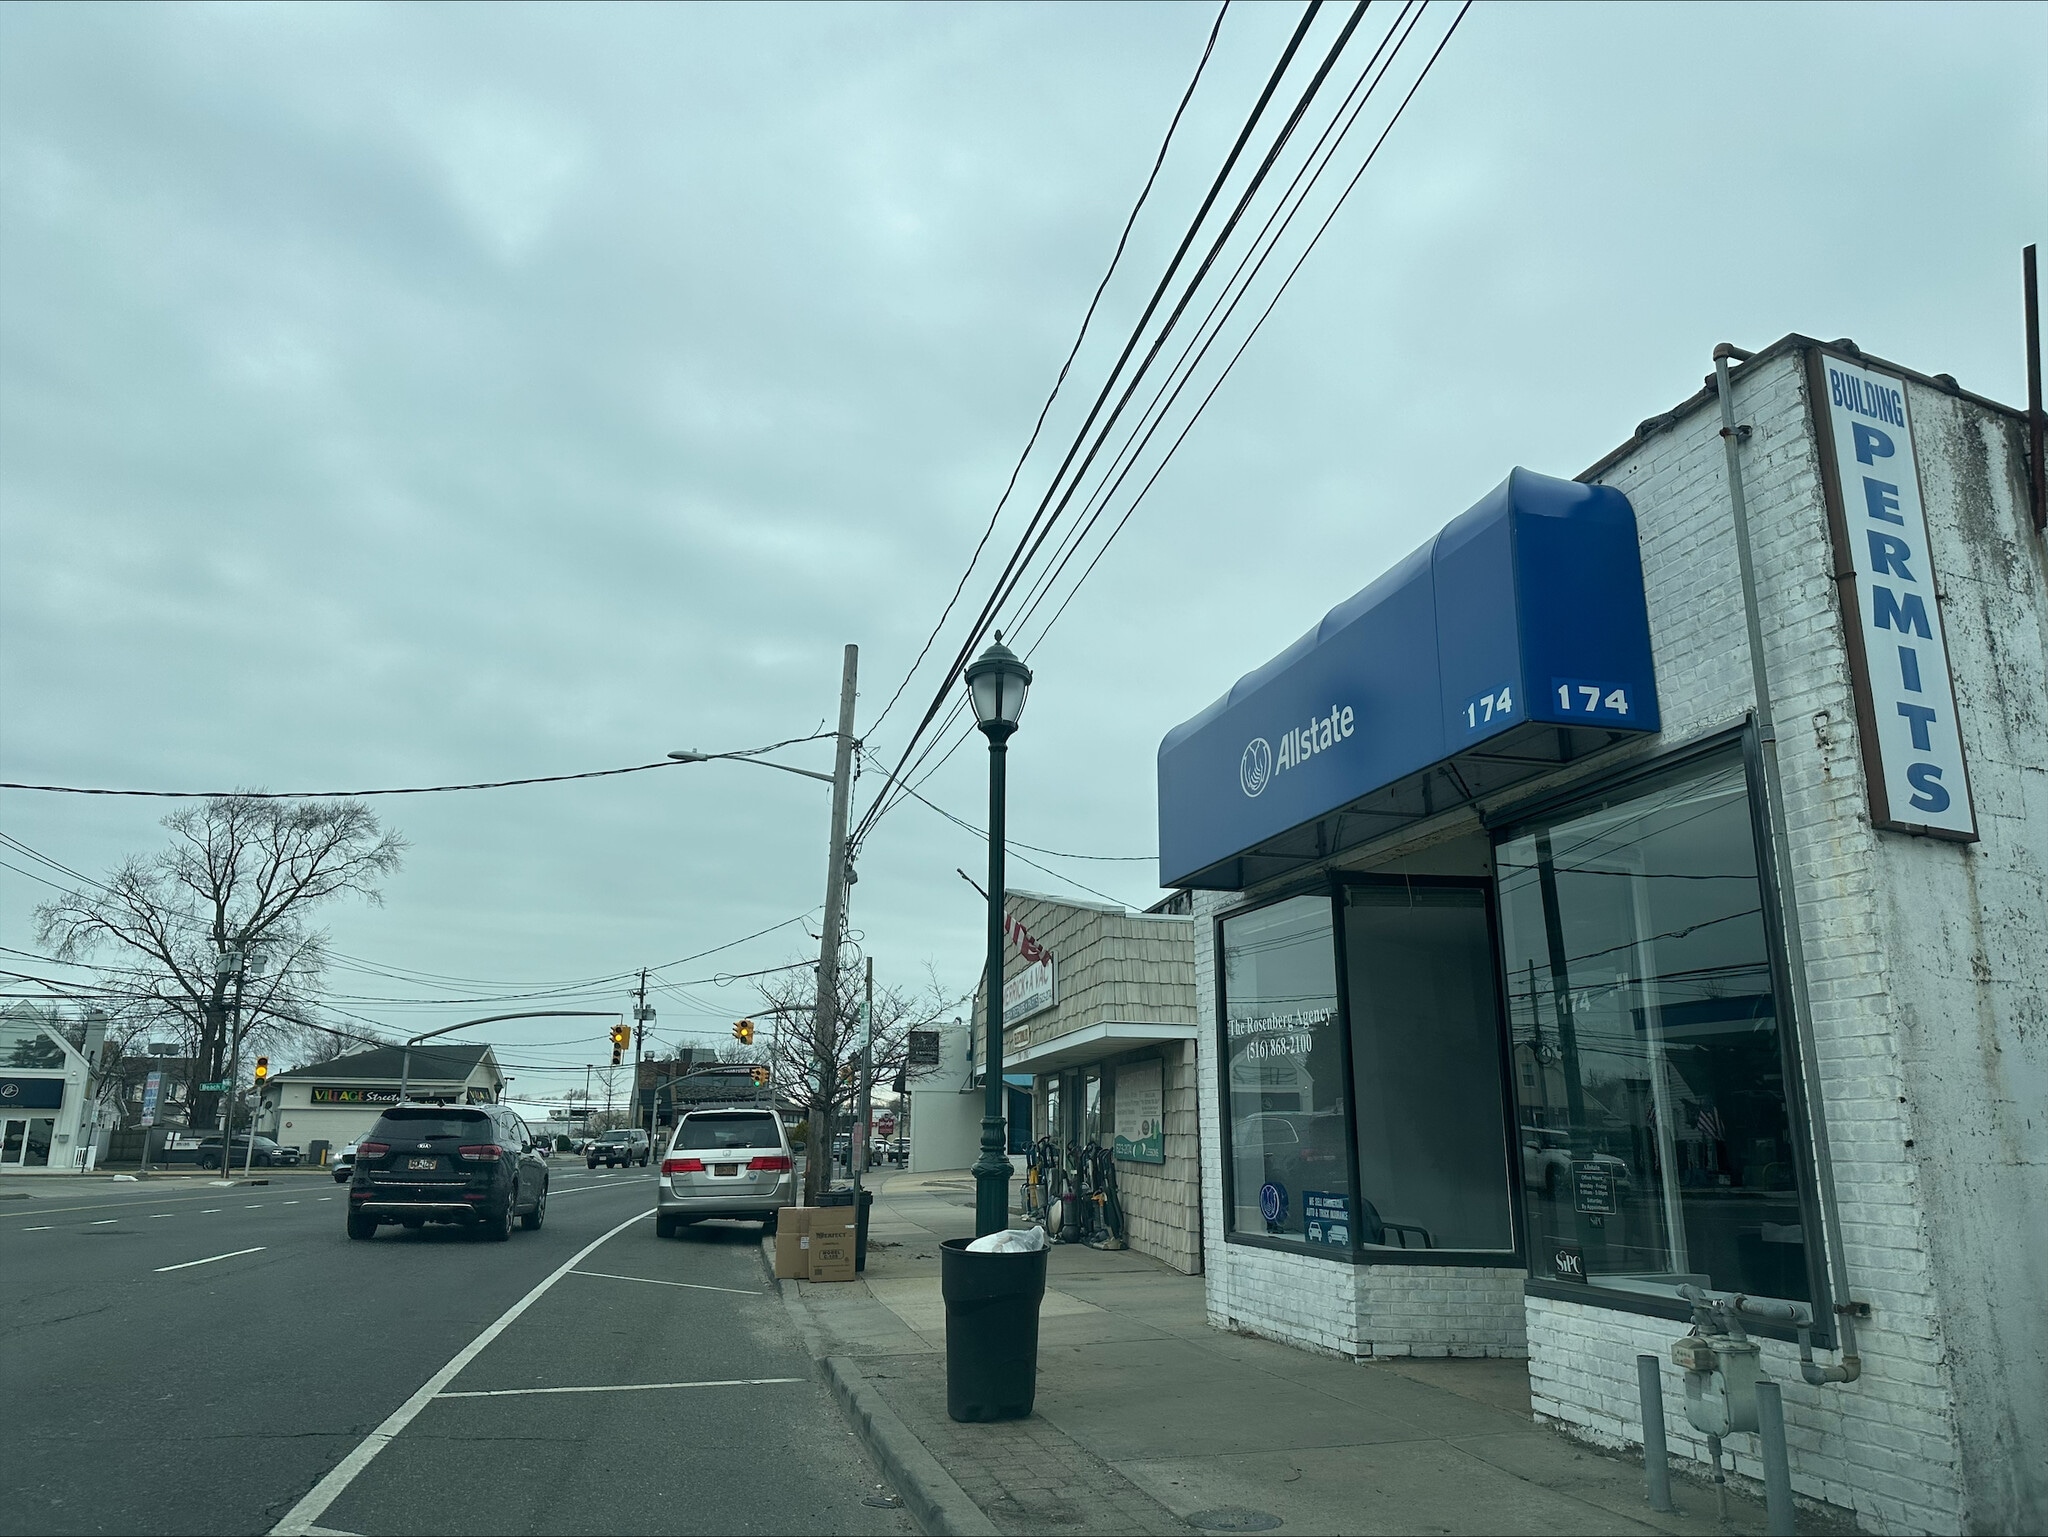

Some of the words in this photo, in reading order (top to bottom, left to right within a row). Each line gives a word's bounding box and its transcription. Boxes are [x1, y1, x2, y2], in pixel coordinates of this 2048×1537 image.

[1829, 368, 1905, 428] BUILDING
[1851, 421, 1950, 813] PERMITS
[1467, 686, 1513, 729] 174
[1558, 683, 1629, 716] 174
[1275, 703, 1355, 776] Allstate
[1558, 990, 1591, 1015] 174
[1229, 1019, 1245, 1036] The
[1247, 1012, 1294, 1035] Rosenberg
[1296, 1006, 1332, 1029] Agency
[1246, 1039, 1269, 1062] (516)
[1270, 1033, 1313, 1056] 868-2100
[314, 1089, 364, 1101] VILLAGE
